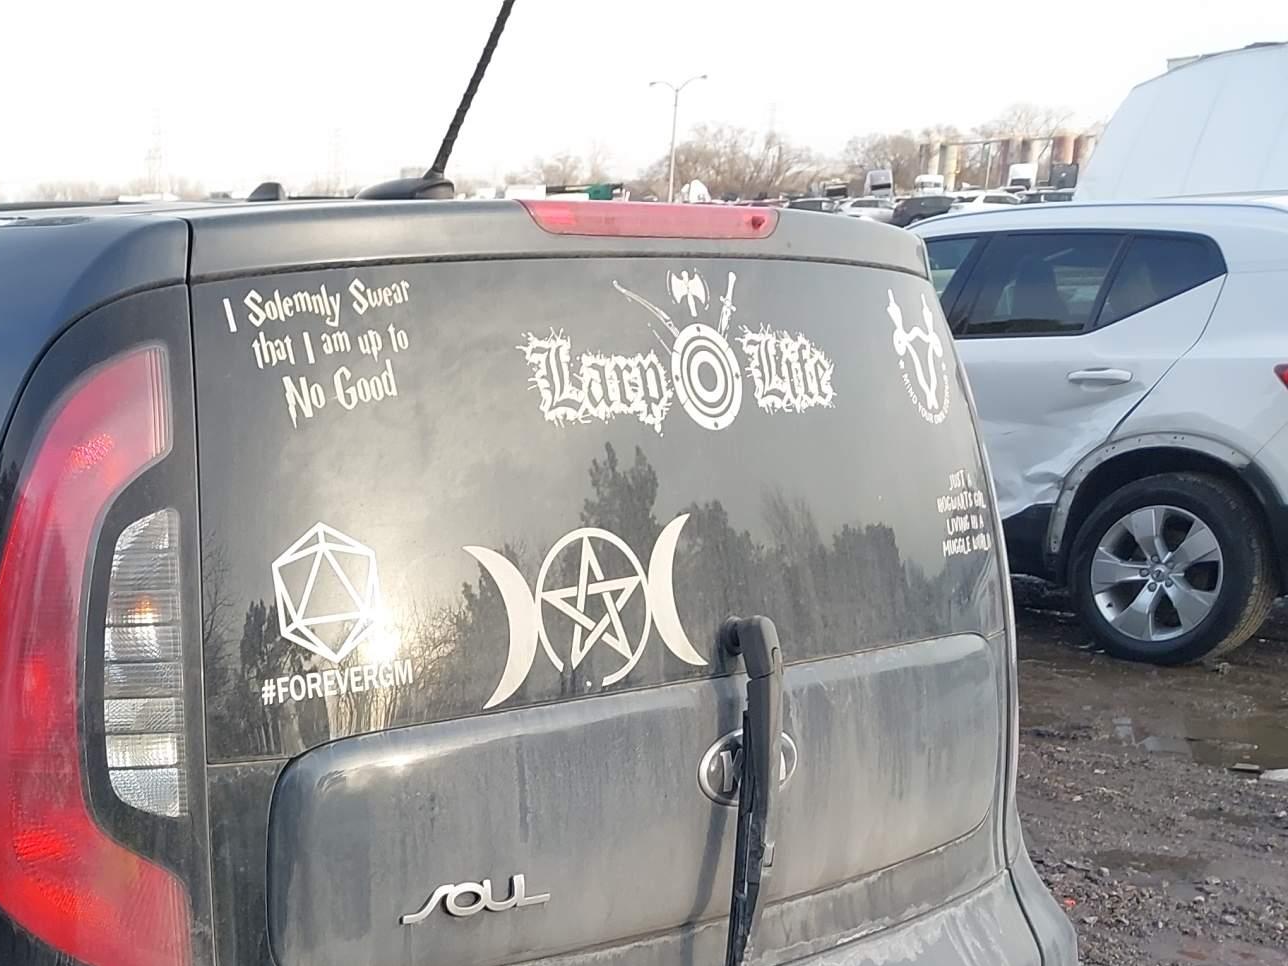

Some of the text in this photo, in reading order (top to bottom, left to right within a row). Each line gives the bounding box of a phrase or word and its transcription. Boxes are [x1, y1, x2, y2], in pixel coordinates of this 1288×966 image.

[223, 278, 410, 332] I Solemnly Swear
[252, 323, 409, 369] that I am up to
[282, 359, 398, 429] No Good
[516, 327, 673, 437] Larp
[936, 491, 972, 513] HOGWARTS
[949, 469, 965, 491] JUST
[942, 536, 972, 557] MUGGLE
[261, 658, 414, 706] #FOREVERGM
[402, 873, 552, 925] SOUL
